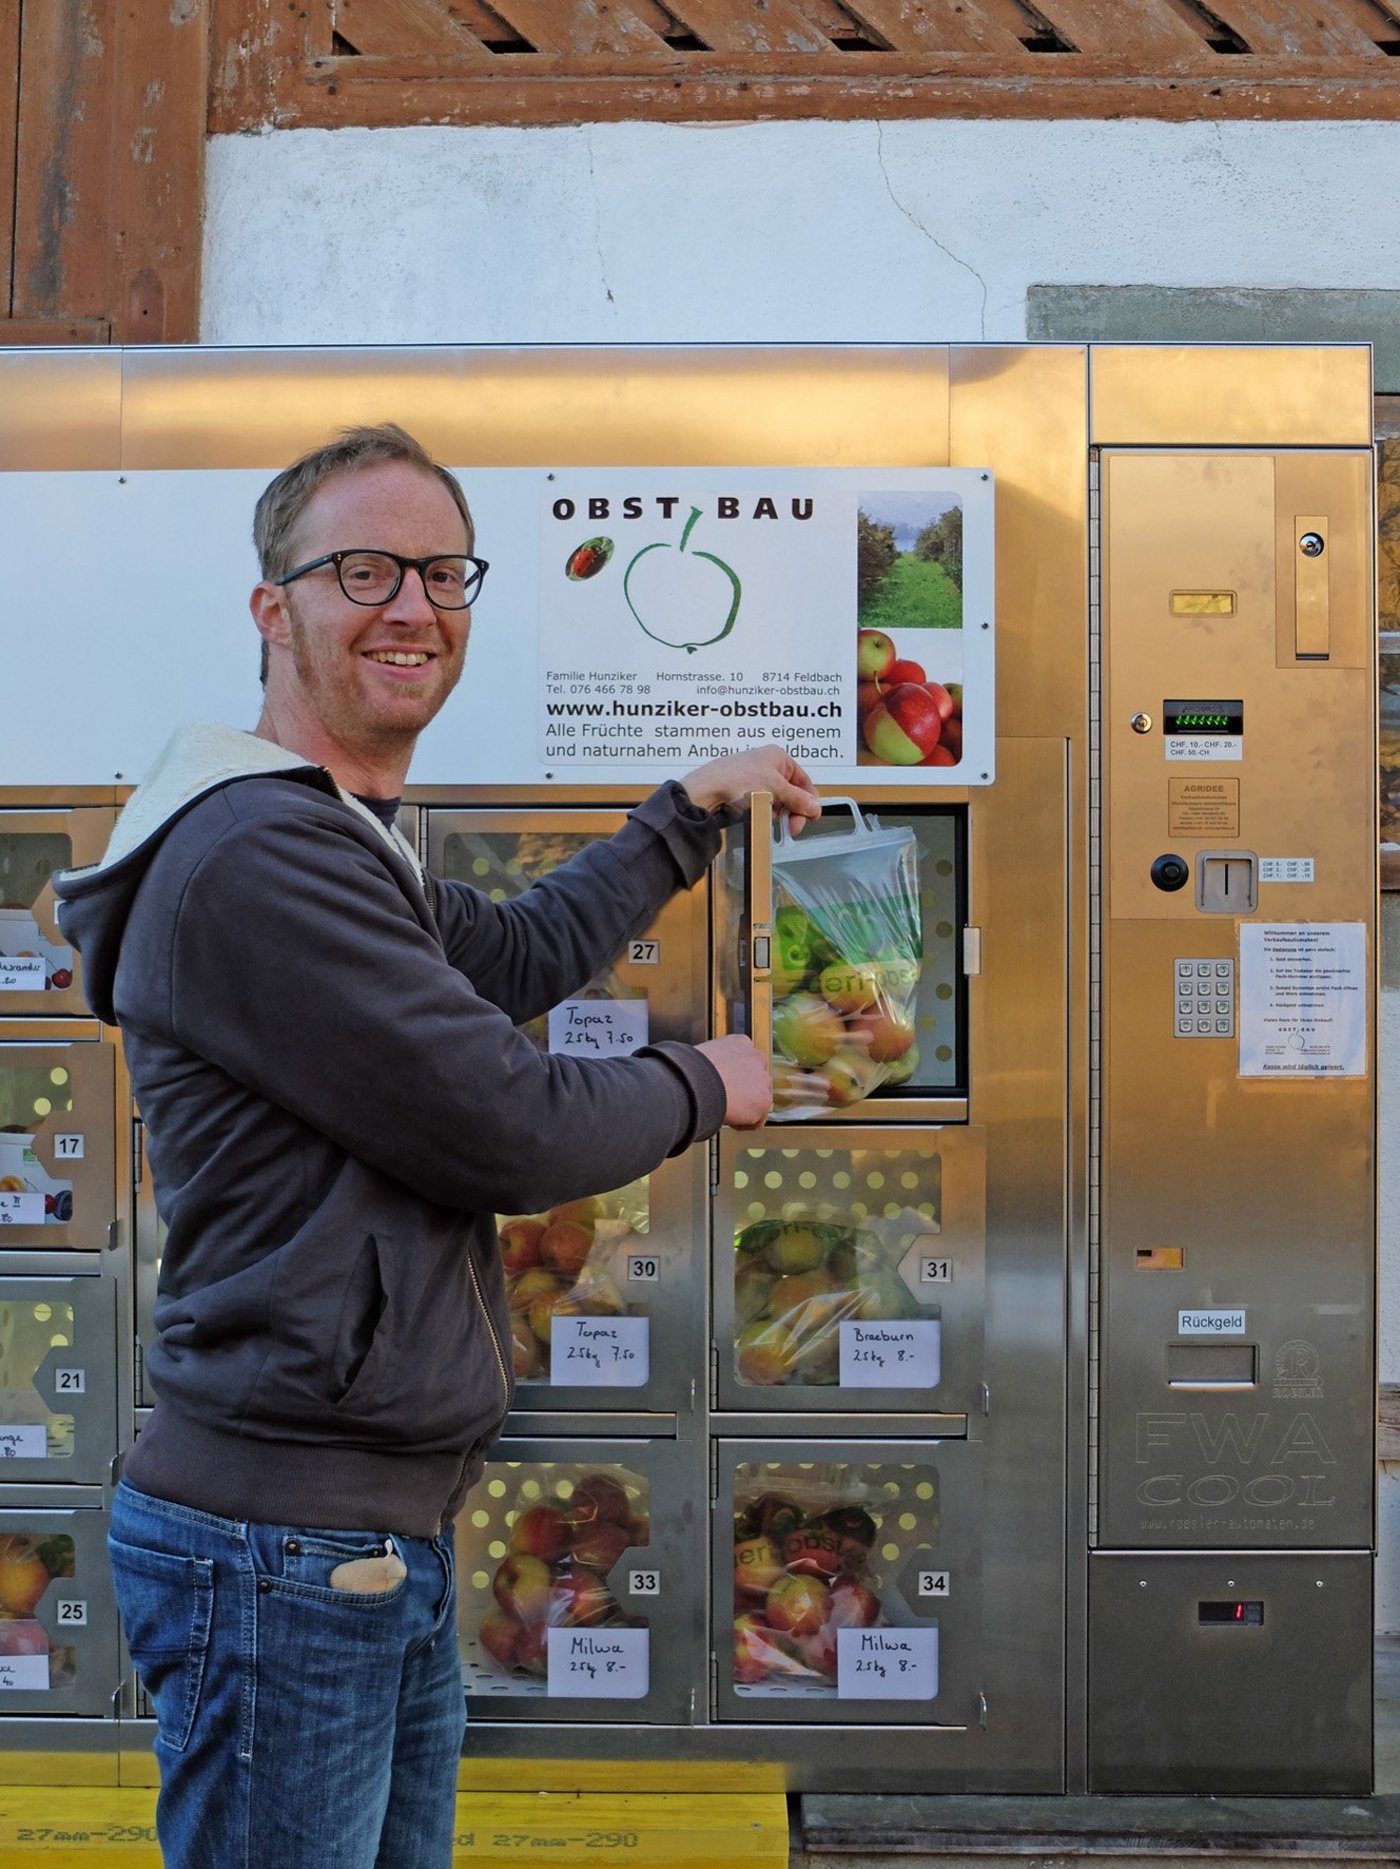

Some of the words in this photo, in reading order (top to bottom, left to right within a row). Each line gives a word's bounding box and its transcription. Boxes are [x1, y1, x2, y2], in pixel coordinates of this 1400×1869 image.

[552, 497, 680, 520] OBST
[717, 497, 814, 520] BAU
[546, 671, 586, 681] Familie
[589, 671, 638, 681] Hunziker
[656, 672, 725, 682] Hornstrasse.
[730, 673, 744, 682] 10
[762, 673, 790, 682] 8714
[794, 673, 842, 682] Feldbach
[546, 685, 566, 694] Tel.
[570, 685, 591, 694] 076
[595, 685, 616, 694] 466
[620, 685, 633, 694] 78
[637, 685, 651, 694] 98
[696, 685, 840, 696] info@hunziker-obstbau.ch
[546, 700, 842, 717] www.hunziker-obstbau.ch
[546, 723, 576, 737] Alle
[582, 723, 643, 737] Früchte
[655, 725, 731, 737] stammen
[737, 727, 766, 738] aus
[772, 725, 841, 741] eigenem
[546, 743, 577, 757] und
[583, 743, 682, 757] naturnahem
[785, 744, 844, 759] ldbach.
[632, 944, 655, 960] 27
[566, 1006, 614, 1028] Topaz
[60, 1138, 79, 1154] 17
[633, 1260, 655, 1276] 30
[927, 1262, 947, 1278] 31
[576, 1321, 618, 1340] Topaz
[1182, 1315, 1242, 1331] Rückgeld
[853, 1327, 914, 1342] Braeburn
[611, 1345, 635, 1360] 7.50
[61, 1373, 80, 1388] 21
[1135, 1412, 1336, 1464] FWA
[1136, 1475, 1336, 1506] COOL
[634, 1574, 656, 1590] 33
[923, 1575, 945, 1591] 34
[62, 1604, 83, 1619] 25
[571, 1637, 624, 1655] Milwa
[861, 1634, 912, 1652] Milwa
